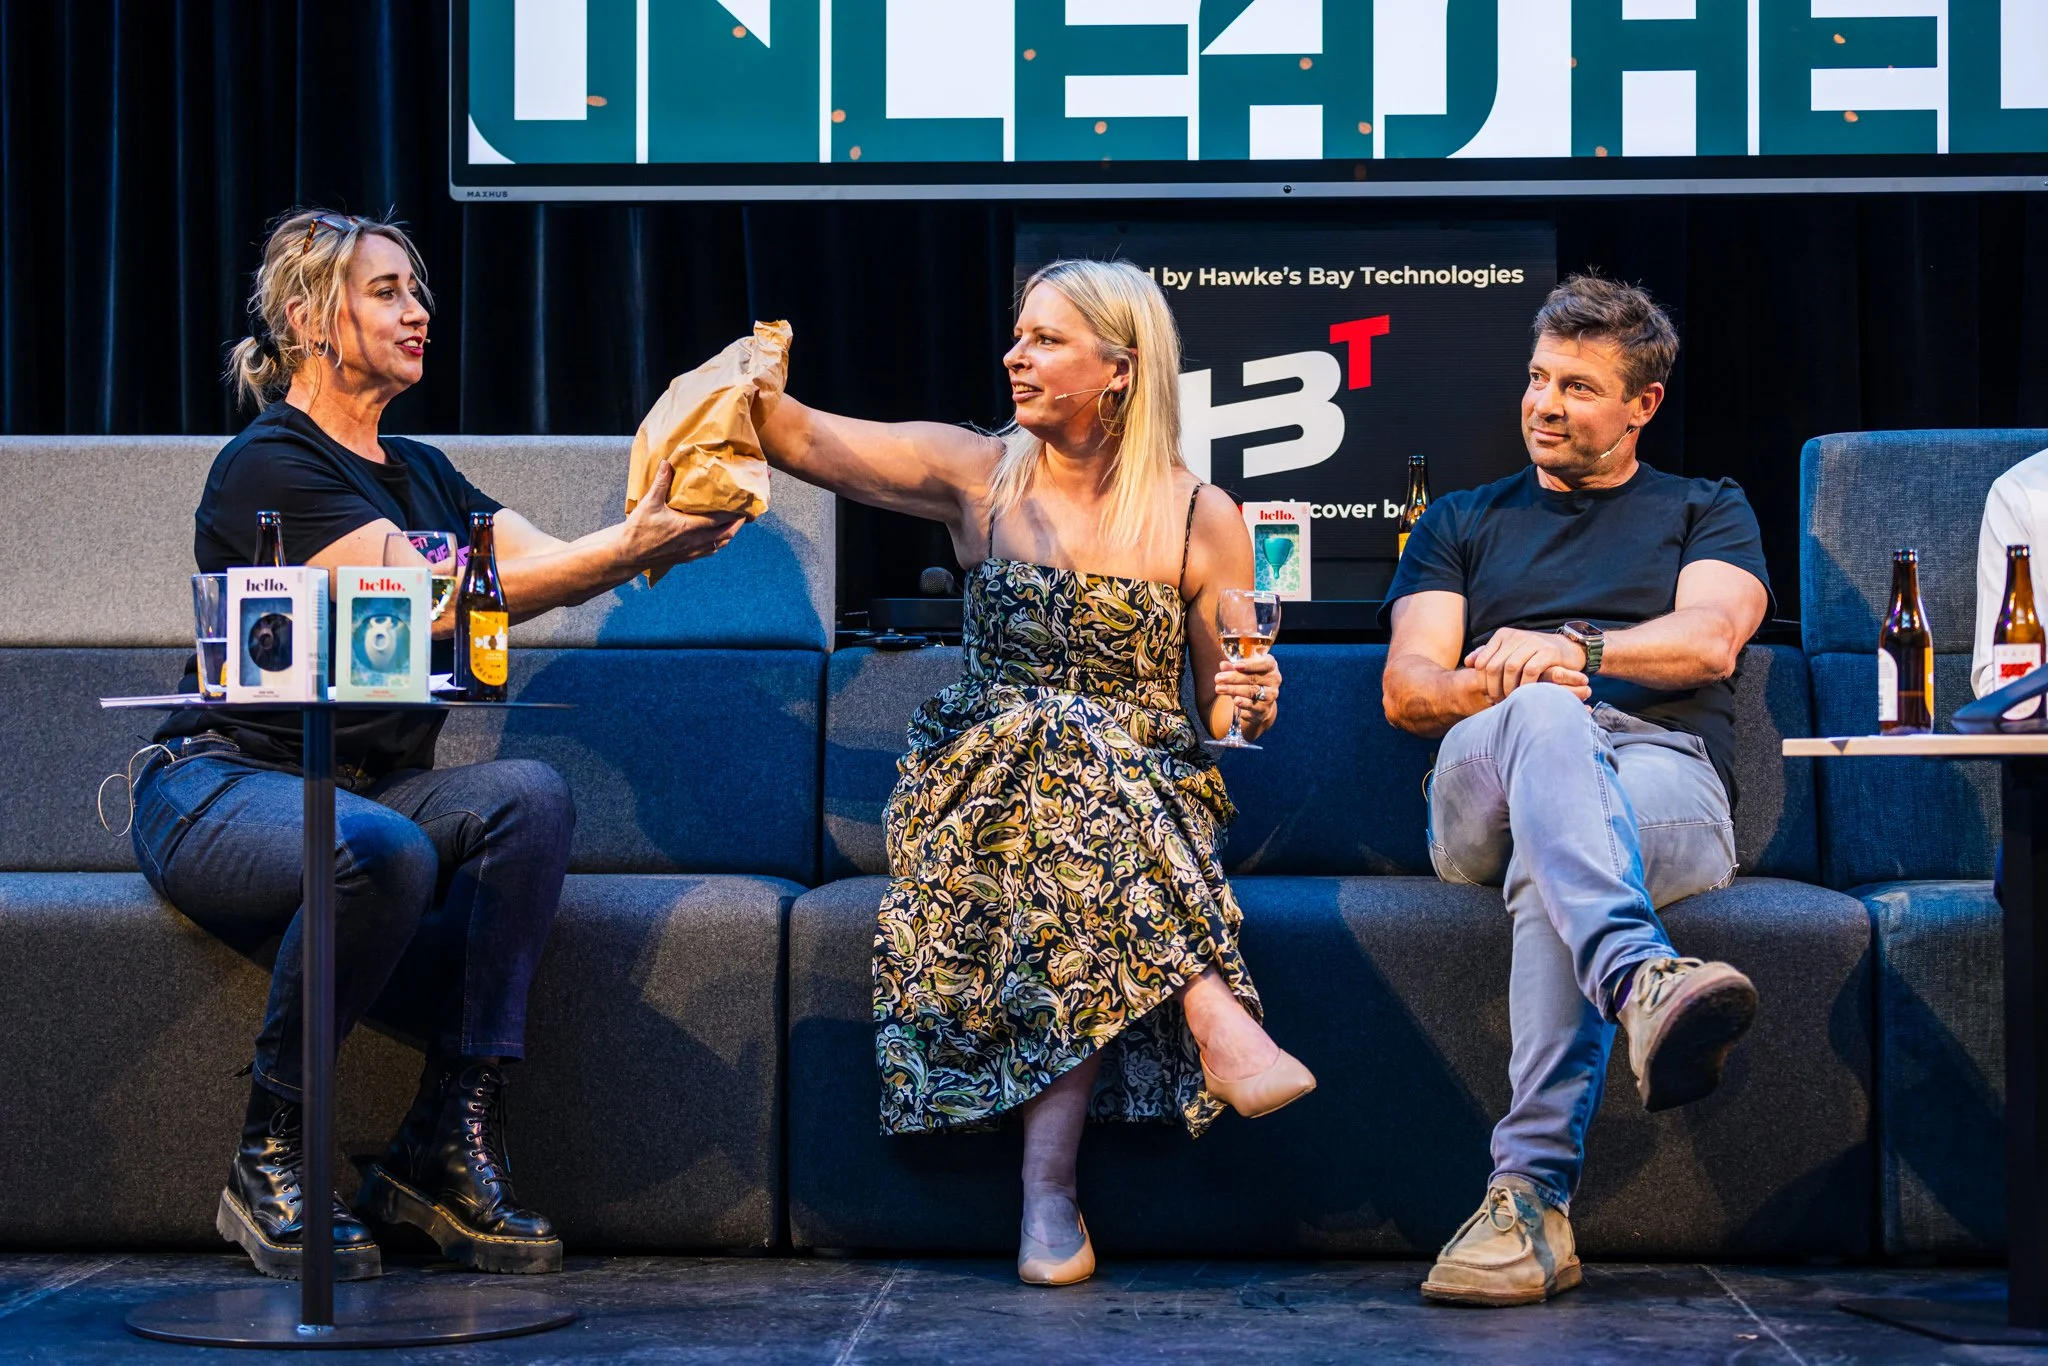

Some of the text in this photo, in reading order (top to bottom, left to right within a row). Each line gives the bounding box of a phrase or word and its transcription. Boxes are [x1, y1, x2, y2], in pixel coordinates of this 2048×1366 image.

[466, 190, 509, 198] MAXHUB
[1162, 267, 1193, 291] by
[1199, 266, 1302, 286] Hawke's
[1308, 267, 1355, 290] Bay
[1359, 264, 1525, 290] Technologies
[1259, 510, 1295, 521] hello.
[1271, 498, 1378, 519] cover
[246, 578, 288, 592] hello.
[359, 578, 406, 592] hello.
